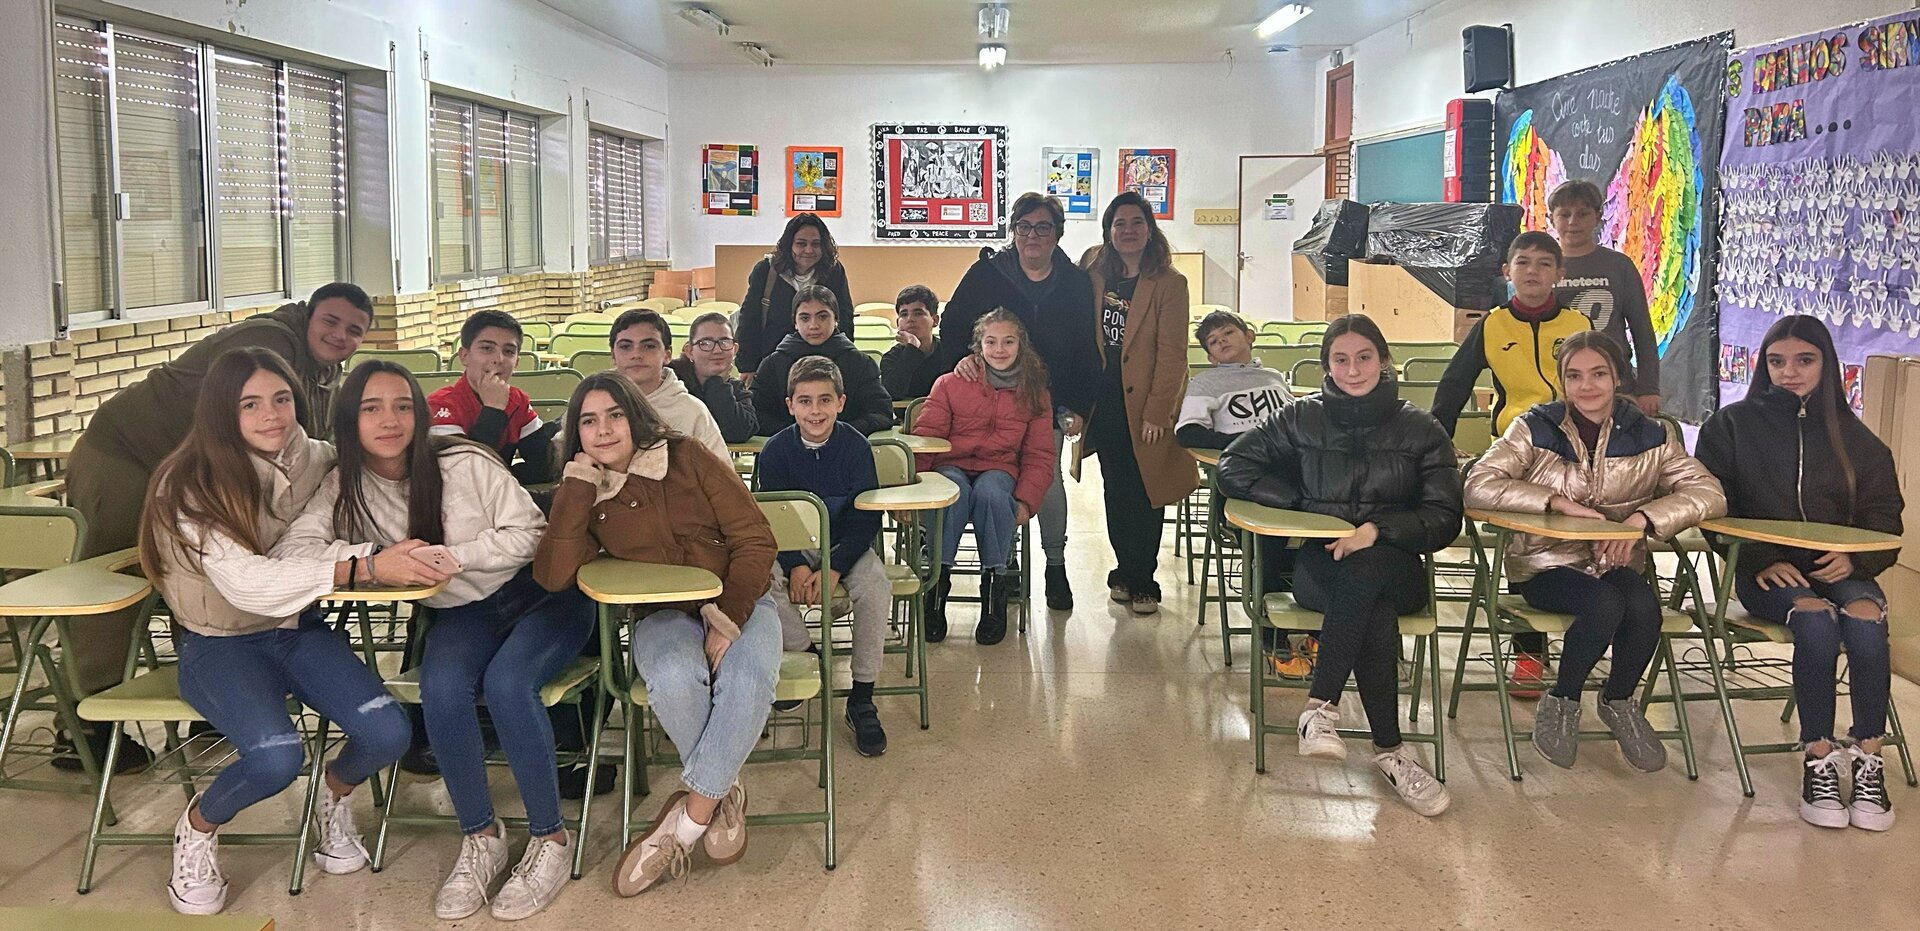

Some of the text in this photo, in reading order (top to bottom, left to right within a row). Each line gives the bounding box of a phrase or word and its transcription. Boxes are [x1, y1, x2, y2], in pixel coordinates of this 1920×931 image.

[1752, 32, 1847, 95] MANOS
[1552, 92, 1578, 122] Que
[1572, 113, 1615, 144] corte tus
[1579, 143, 1601, 172] alas
